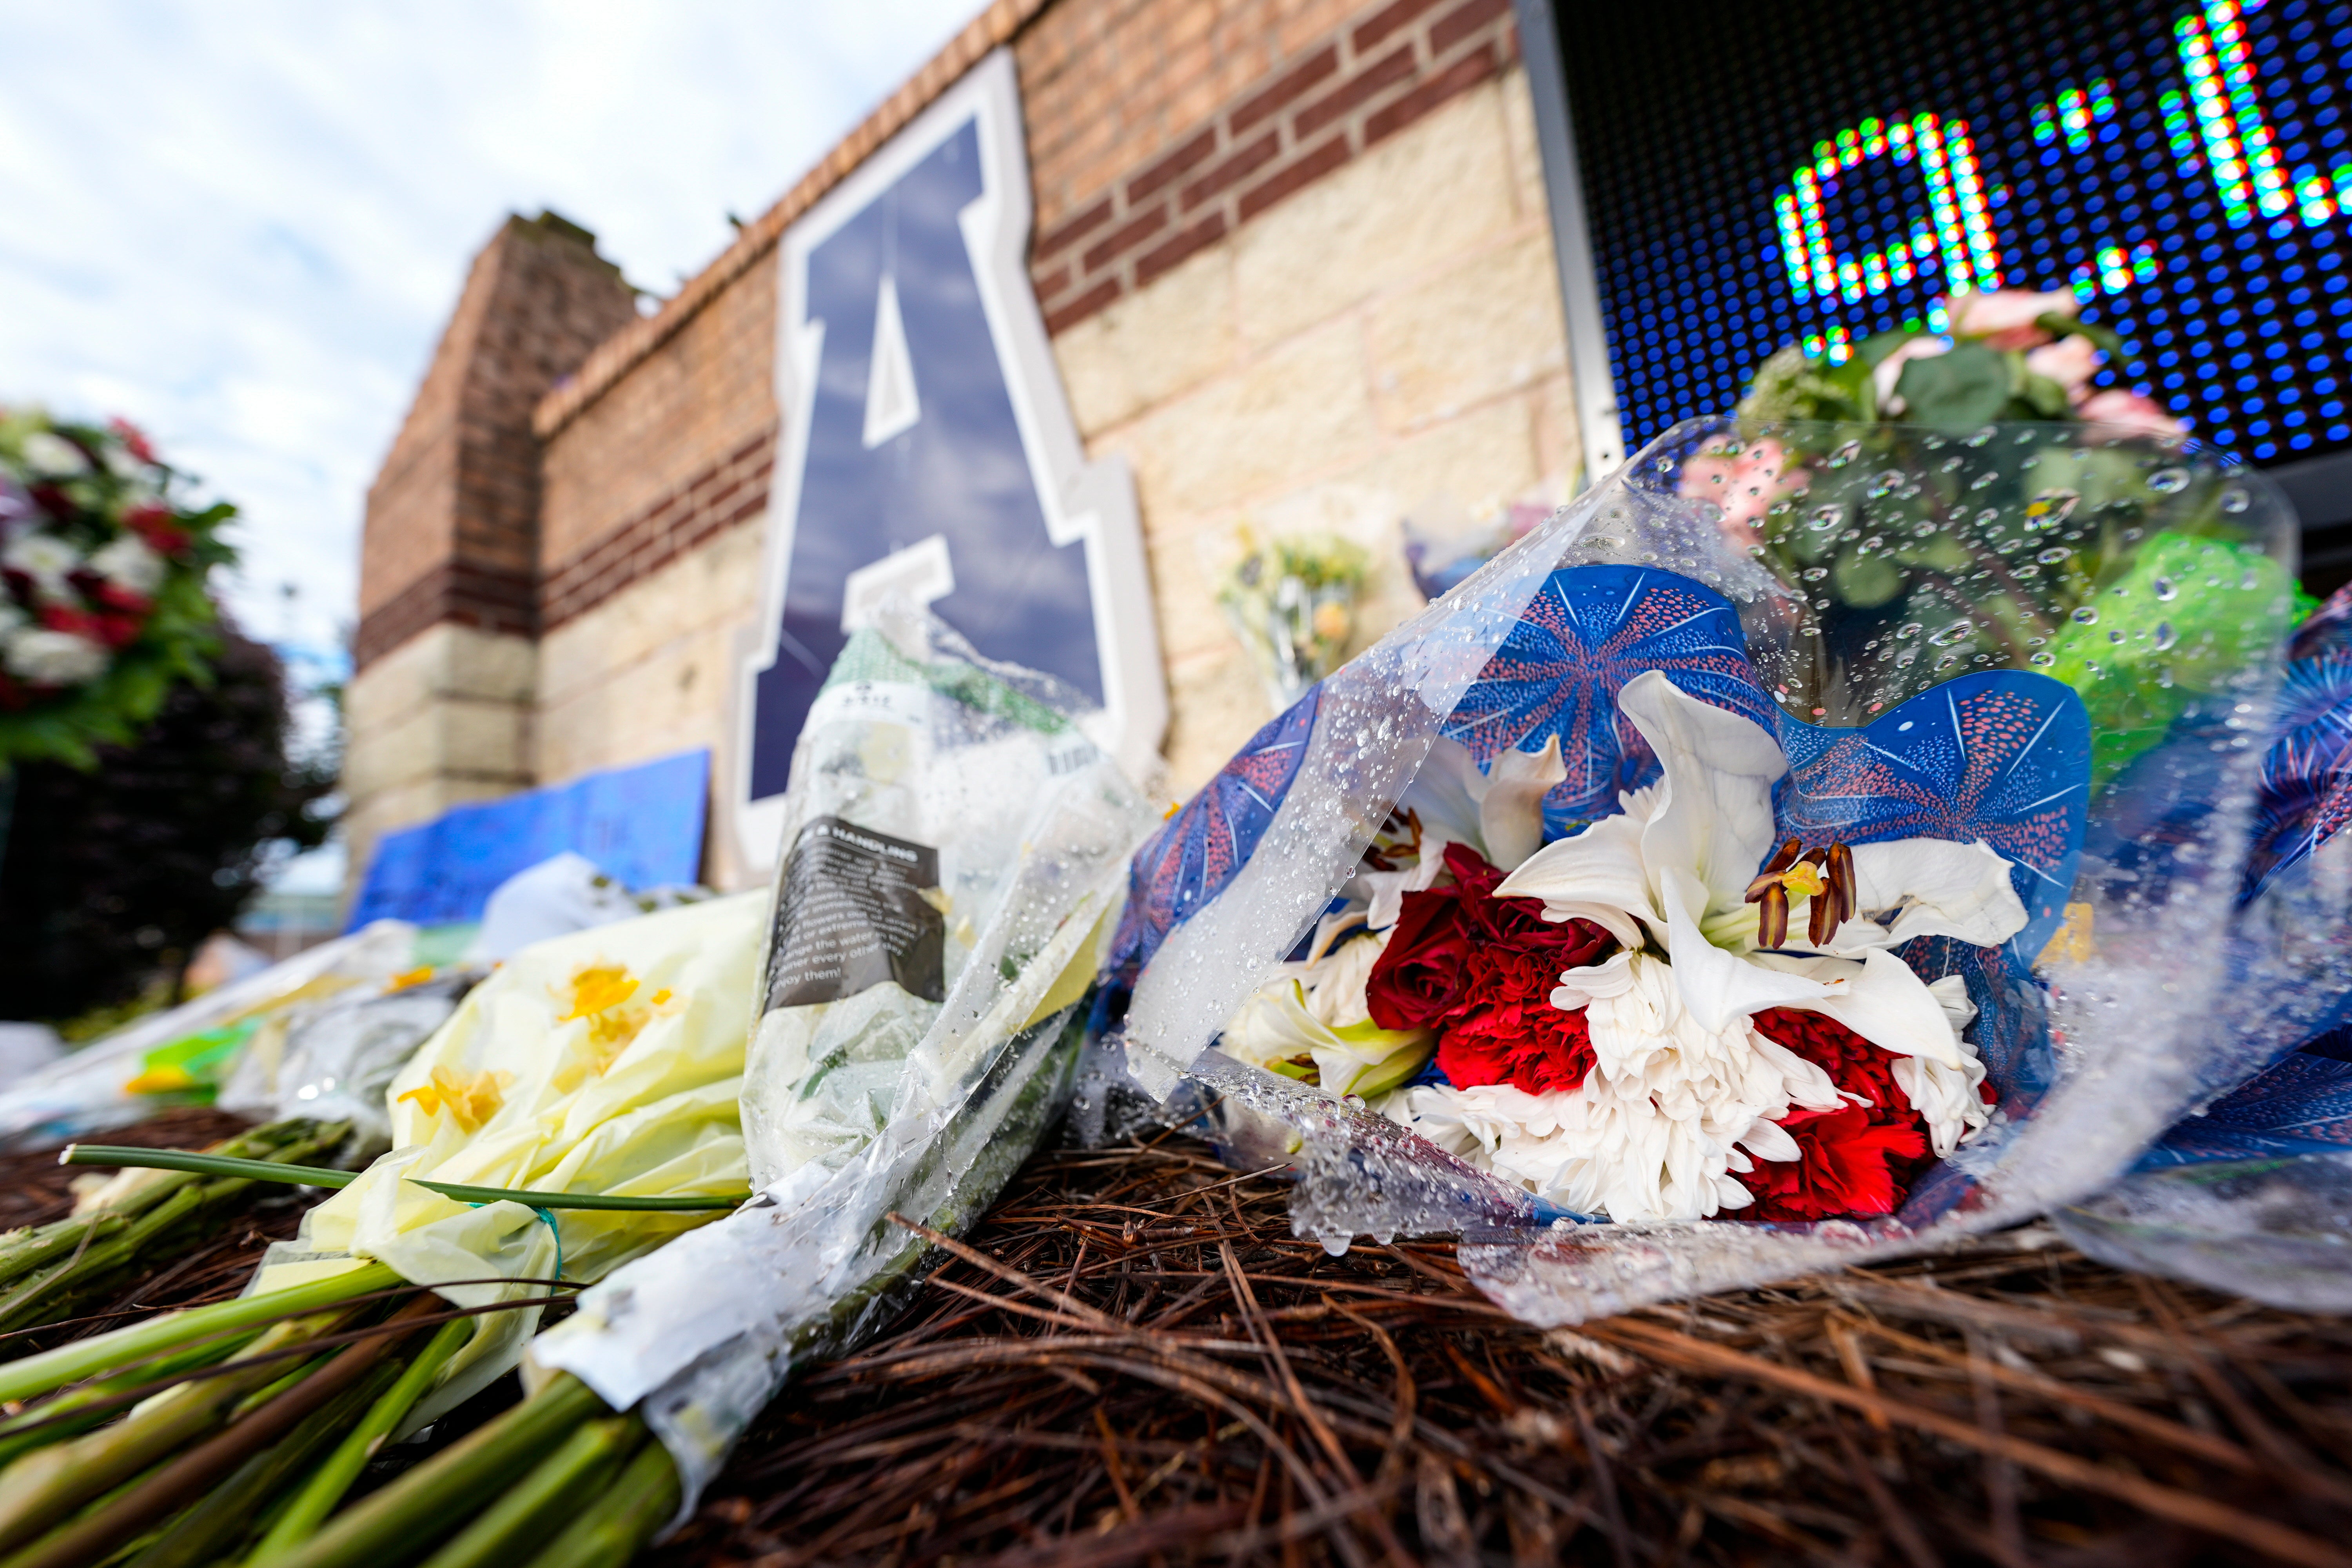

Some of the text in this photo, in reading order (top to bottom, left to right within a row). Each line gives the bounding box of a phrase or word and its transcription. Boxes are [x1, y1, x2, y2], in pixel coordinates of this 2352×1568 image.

[737, 51, 1160, 862] A
[832, 826, 918, 862] HANDLING
[803, 912, 844, 929] flowers
[884, 917, 916, 932] direct
[804, 930, 815, 940] or
[818, 920, 868, 935] extreme
[816, 939, 837, 950] the
[839, 931, 873, 946] water
[889, 934, 907, 947] the
[812, 952, 847, 964] every
[849, 942, 880, 959] other
[804, 966, 841, 982] them!
